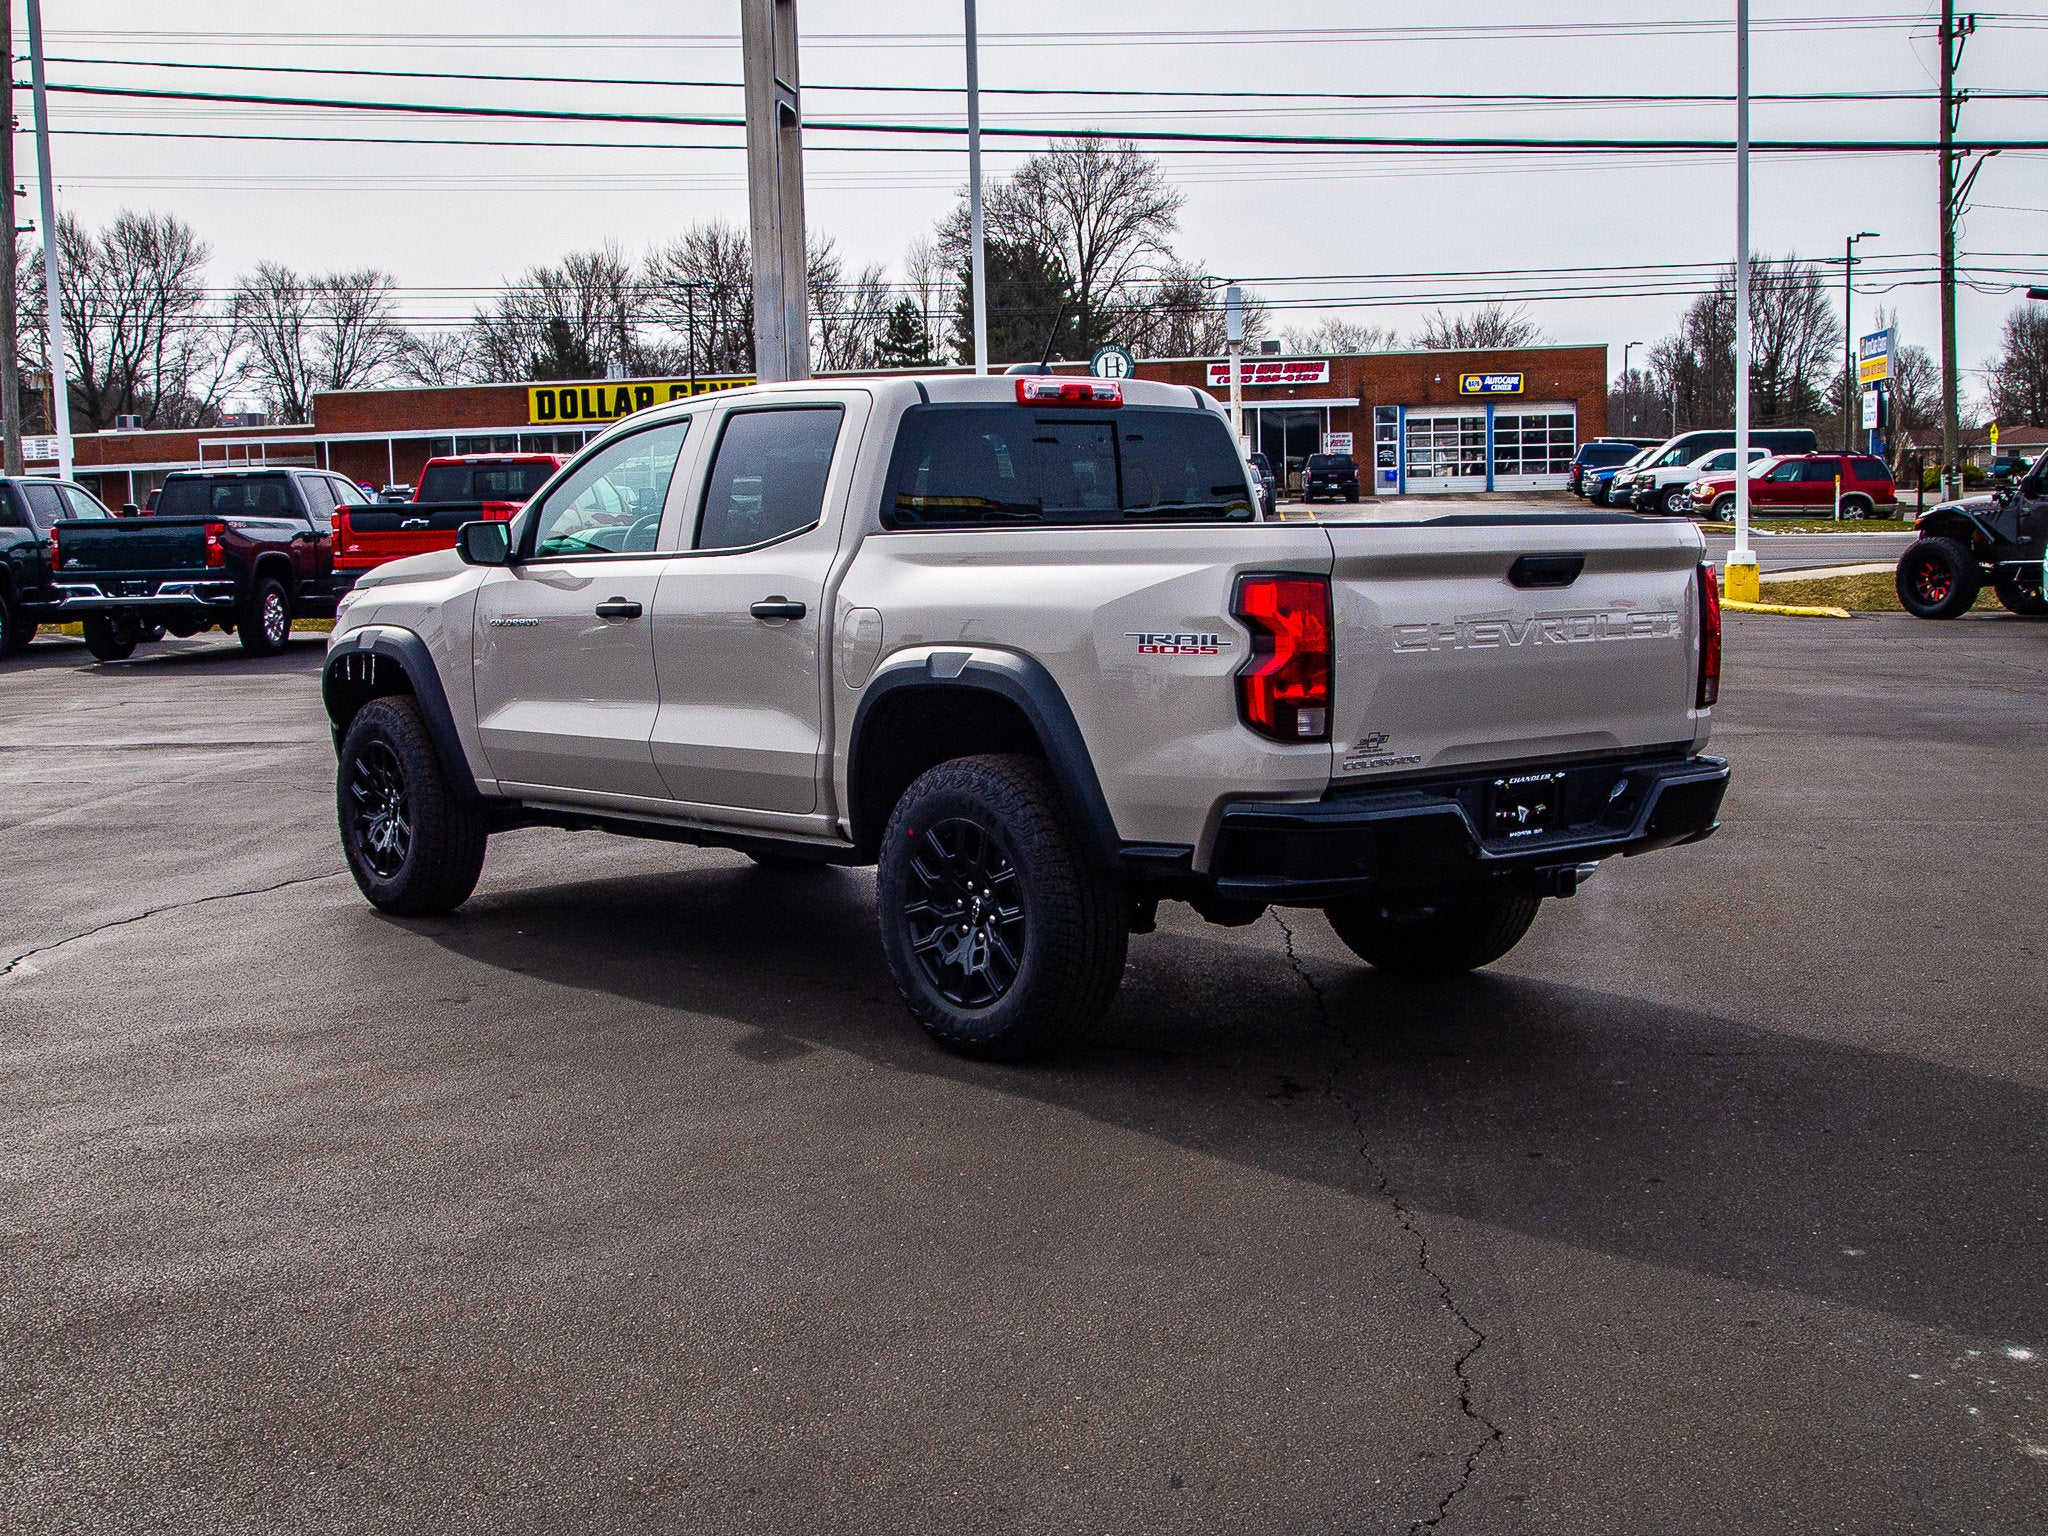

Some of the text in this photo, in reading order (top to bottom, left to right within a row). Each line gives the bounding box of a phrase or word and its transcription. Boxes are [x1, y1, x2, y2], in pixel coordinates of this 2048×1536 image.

[1256, 364, 1283, 374] AUTO
[1283, 362, 1326, 373] SERVICE
[536, 386, 654, 420] DOLLAR
[490, 618, 539, 627] COLORADO
[1392, 611, 1682, 652] CHEVROLET
[1124, 633, 1232, 646] TRAIL
[1137, 645, 1219, 655] BOSS
[1343, 754, 1421, 770] COLORADO
[1509, 774, 1551, 784] CHANDLER
